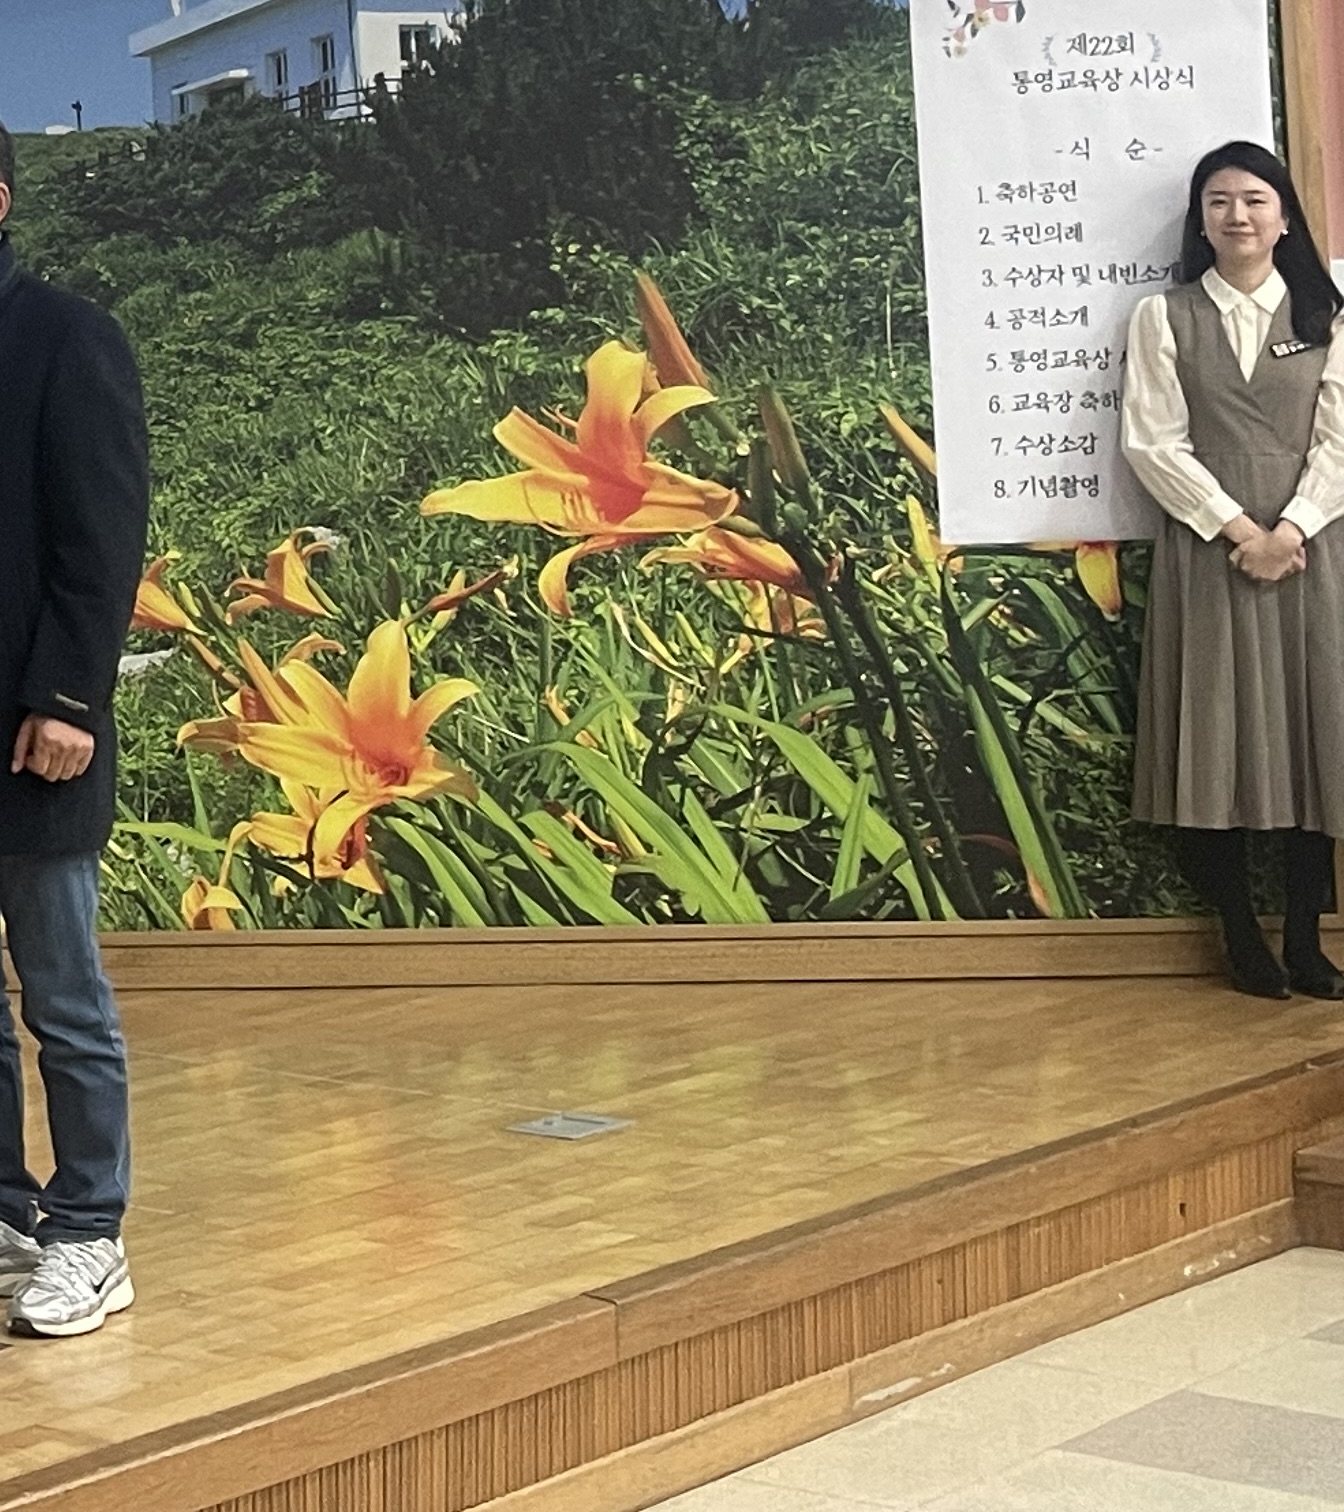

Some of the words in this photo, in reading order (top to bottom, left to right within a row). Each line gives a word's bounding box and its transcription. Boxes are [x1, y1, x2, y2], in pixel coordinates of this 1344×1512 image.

[1066, 32, 1135, 56] 제22회
[1012, 67, 1123, 95] 통영교육상
[1130, 65, 1194, 91] 시상식
[977, 186, 990, 204] 1.
[995, 180, 1078, 204] 축하공연
[979, 227, 995, 246] 2.
[1001, 222, 1084, 245] 국민의례
[982, 268, 998, 287] 3.
[1003, 264, 1064, 288] 수상자
[1072, 264, 1092, 287] 및
[984, 311, 1000, 330] 4.
[1007, 305, 1089, 331] 공적소개
[985, 353, 1003, 371] 5.
[1008, 347, 1113, 373] 통영교육상
[989, 395, 1005, 414] 6.
[1011, 390, 1074, 413] 교육장
[991, 437, 1009, 456] 7.
[1015, 432, 1098, 456] 수상소감
[994, 480, 1011, 499] 8.
[1017, 474, 1100, 499] 기념촬영
